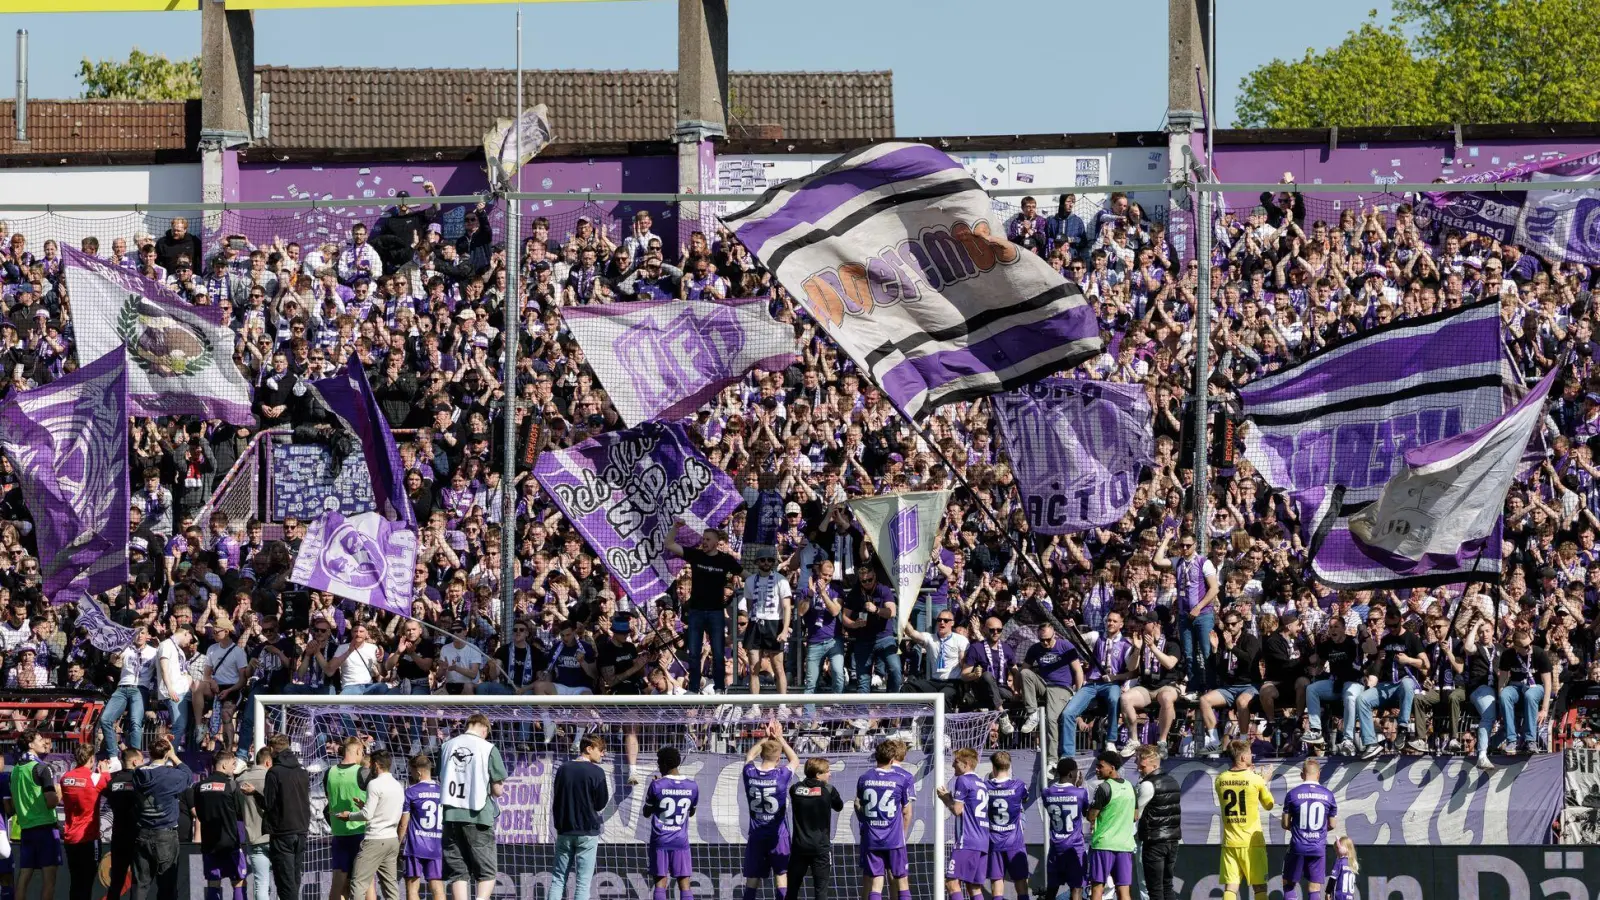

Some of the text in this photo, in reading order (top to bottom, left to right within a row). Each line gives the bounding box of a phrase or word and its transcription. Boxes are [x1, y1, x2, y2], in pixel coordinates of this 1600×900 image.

[1225, 418, 1234, 461] BECKHOFF
[448, 780, 466, 799] 01
[498, 784, 542, 807] SION
[748, 786, 780, 814] 25
[863, 788, 897, 818] 24
[974, 789, 989, 818] 2
[1222, 788, 1247, 816] 21
[495, 809, 534, 831] ORE
[659, 797, 692, 825] 23
[992, 798, 1010, 825] 3
[1047, 804, 1079, 832] 37
[1300, 801, 1325, 831] 10
